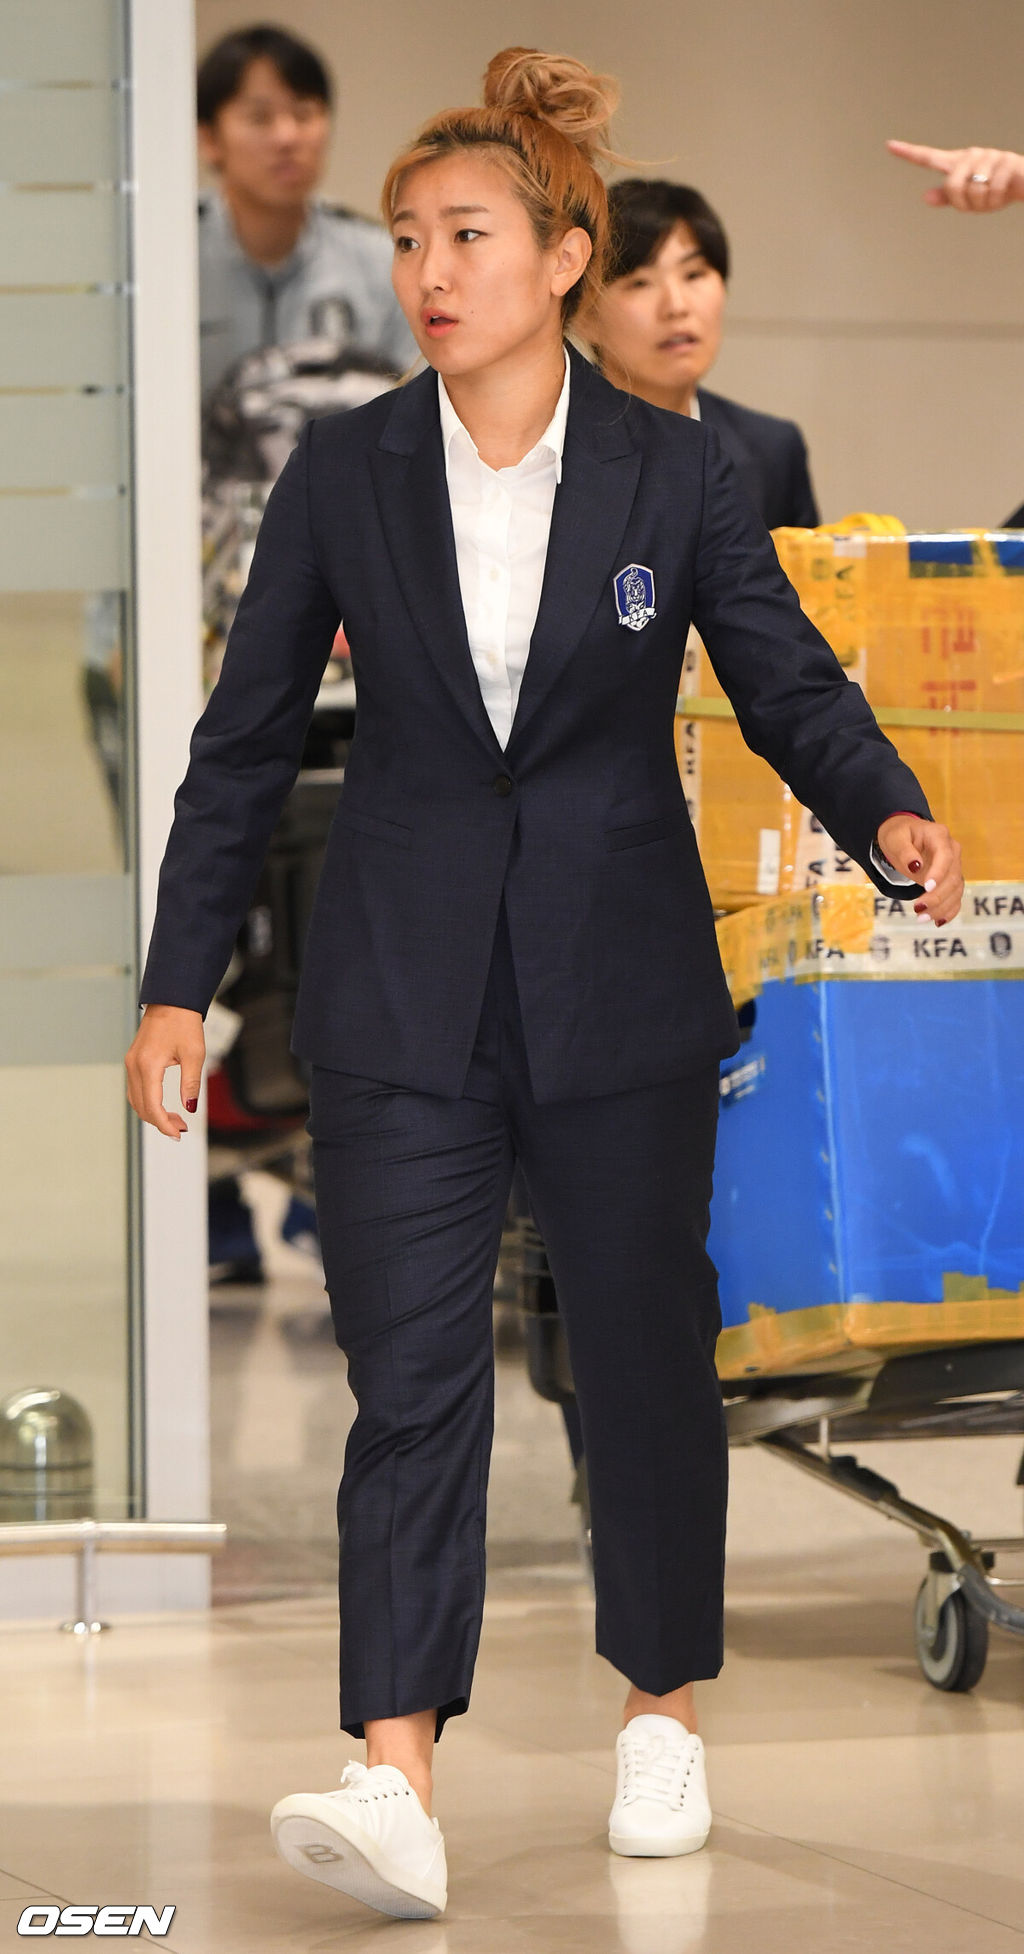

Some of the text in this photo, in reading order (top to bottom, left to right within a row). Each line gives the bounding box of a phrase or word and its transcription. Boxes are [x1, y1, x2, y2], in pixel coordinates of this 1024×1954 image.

[873, 897, 906, 917] FA
[973, 896, 1024, 916] KFA
[913, 937, 968, 958] KFA
